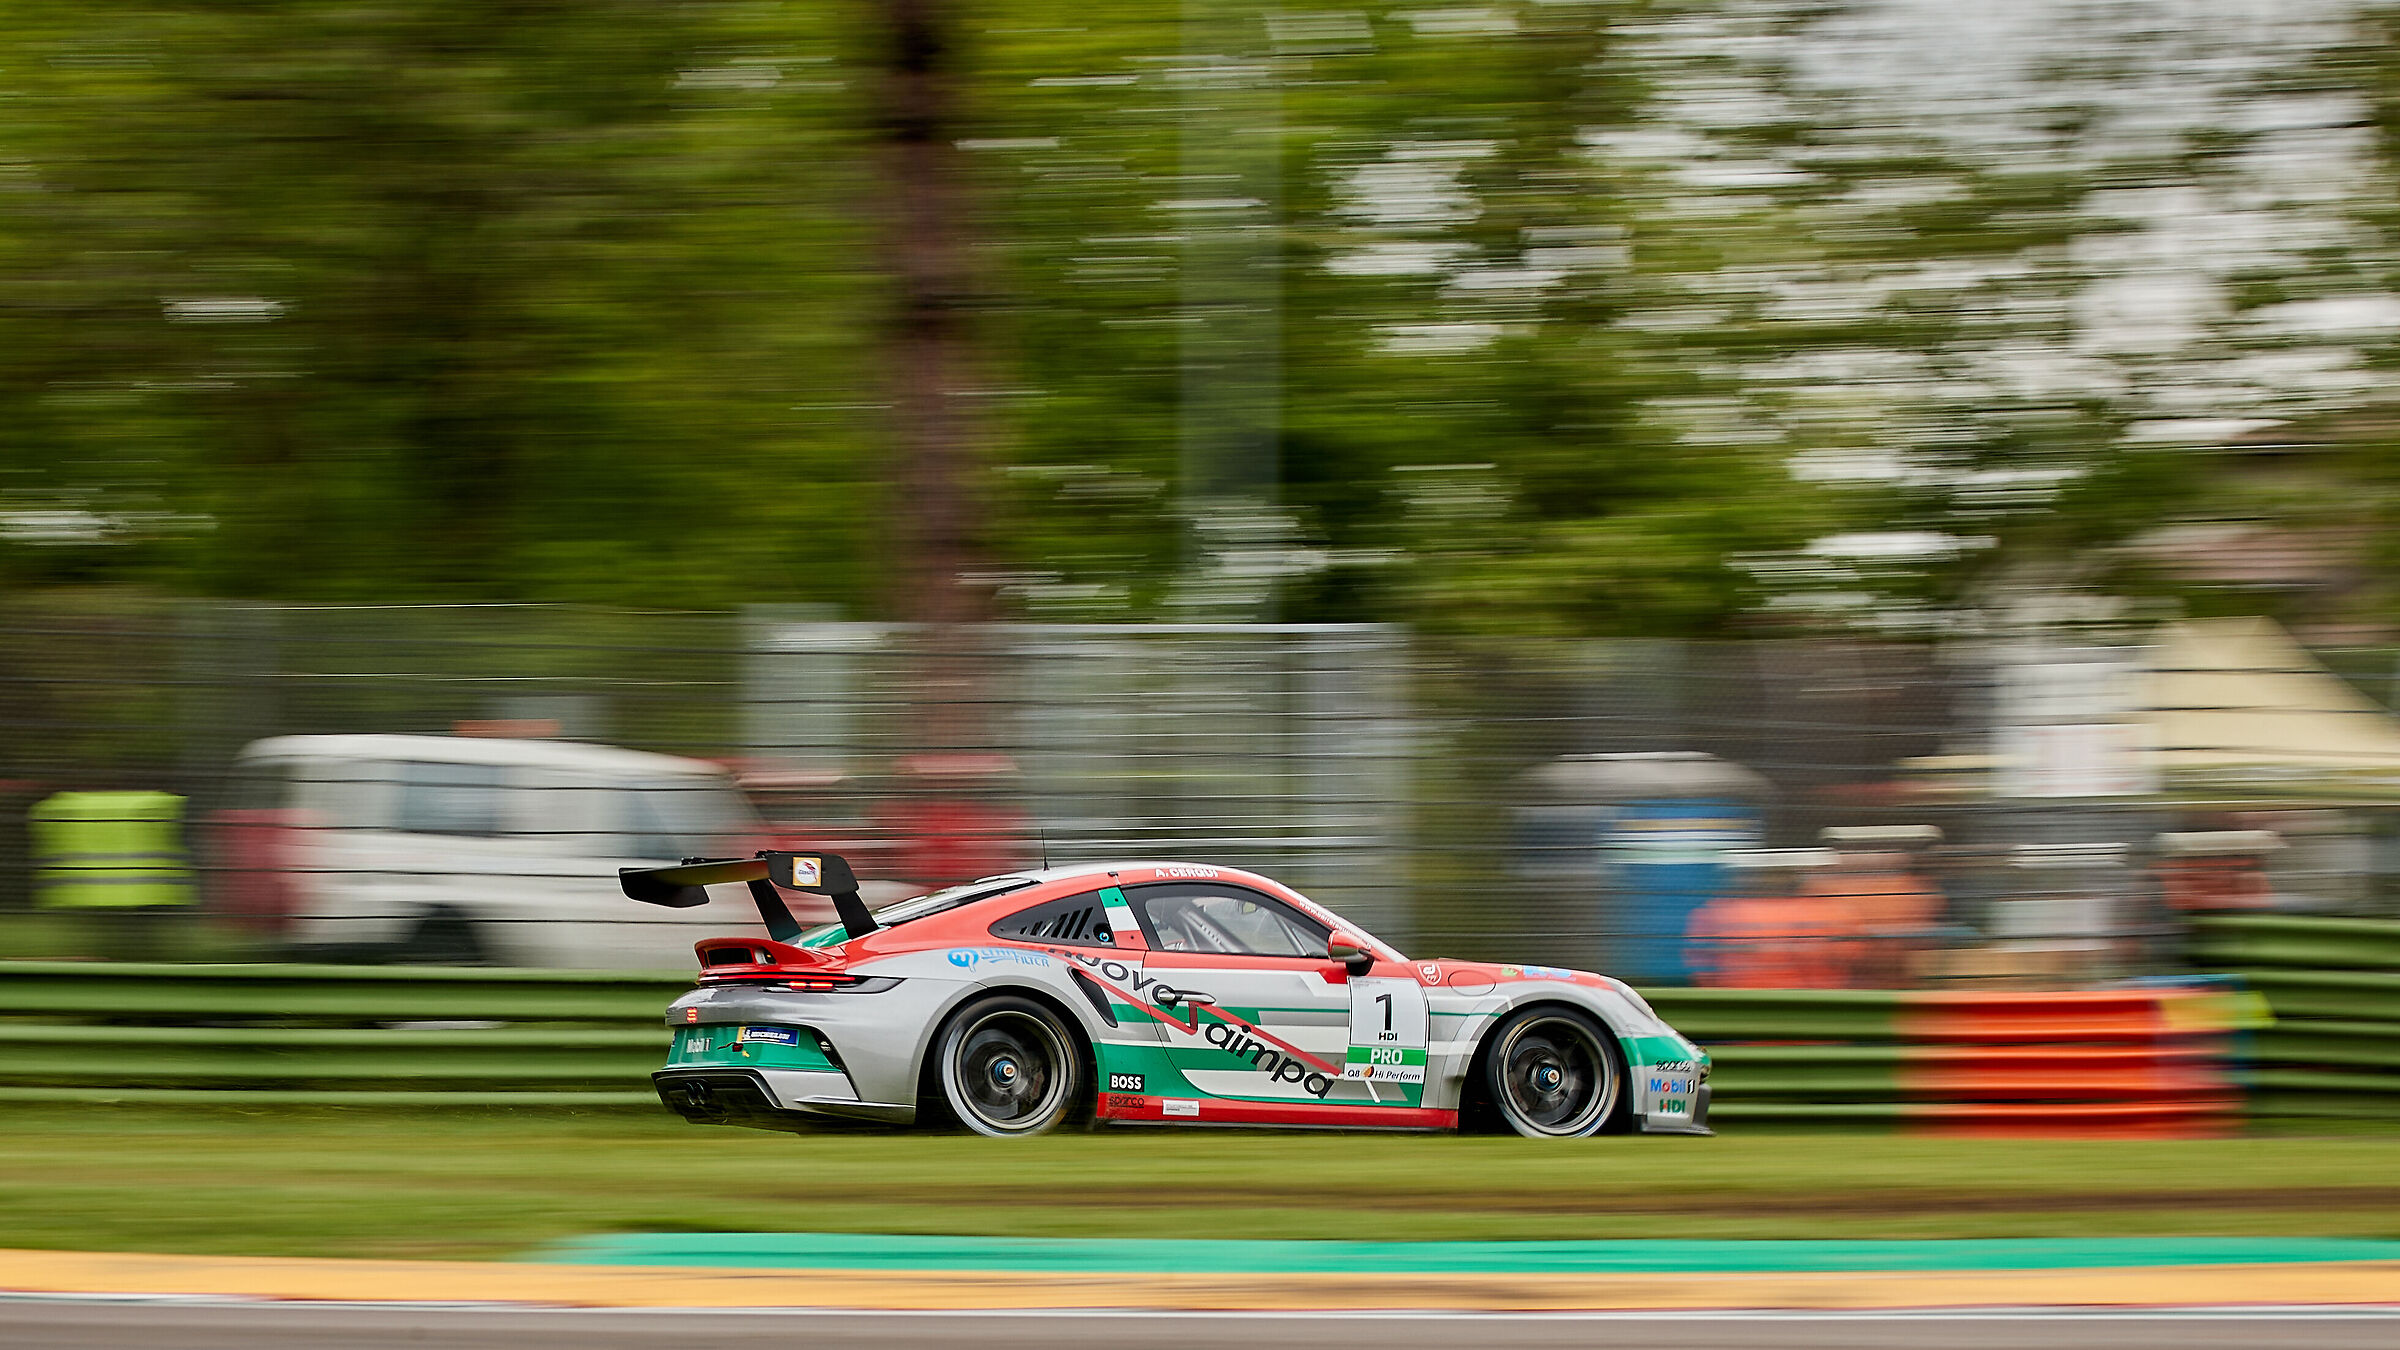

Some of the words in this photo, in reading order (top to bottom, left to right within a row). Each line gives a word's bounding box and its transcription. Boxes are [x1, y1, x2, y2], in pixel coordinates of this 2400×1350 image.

[1375, 993, 1392, 1031] 1
[1378, 1032, 1398, 1041] HDI
[1370, 1048, 1403, 1065] PRO
[1111, 1075, 1142, 1090] BOSS
[1347, 1069, 1361, 1079] Q8
[1374, 1070, 1384, 1079] Hi
[1386, 1071, 1420, 1083] Perform
[1650, 1078, 1686, 1094] Mobil
[1659, 1099, 1686, 1113] HDI
